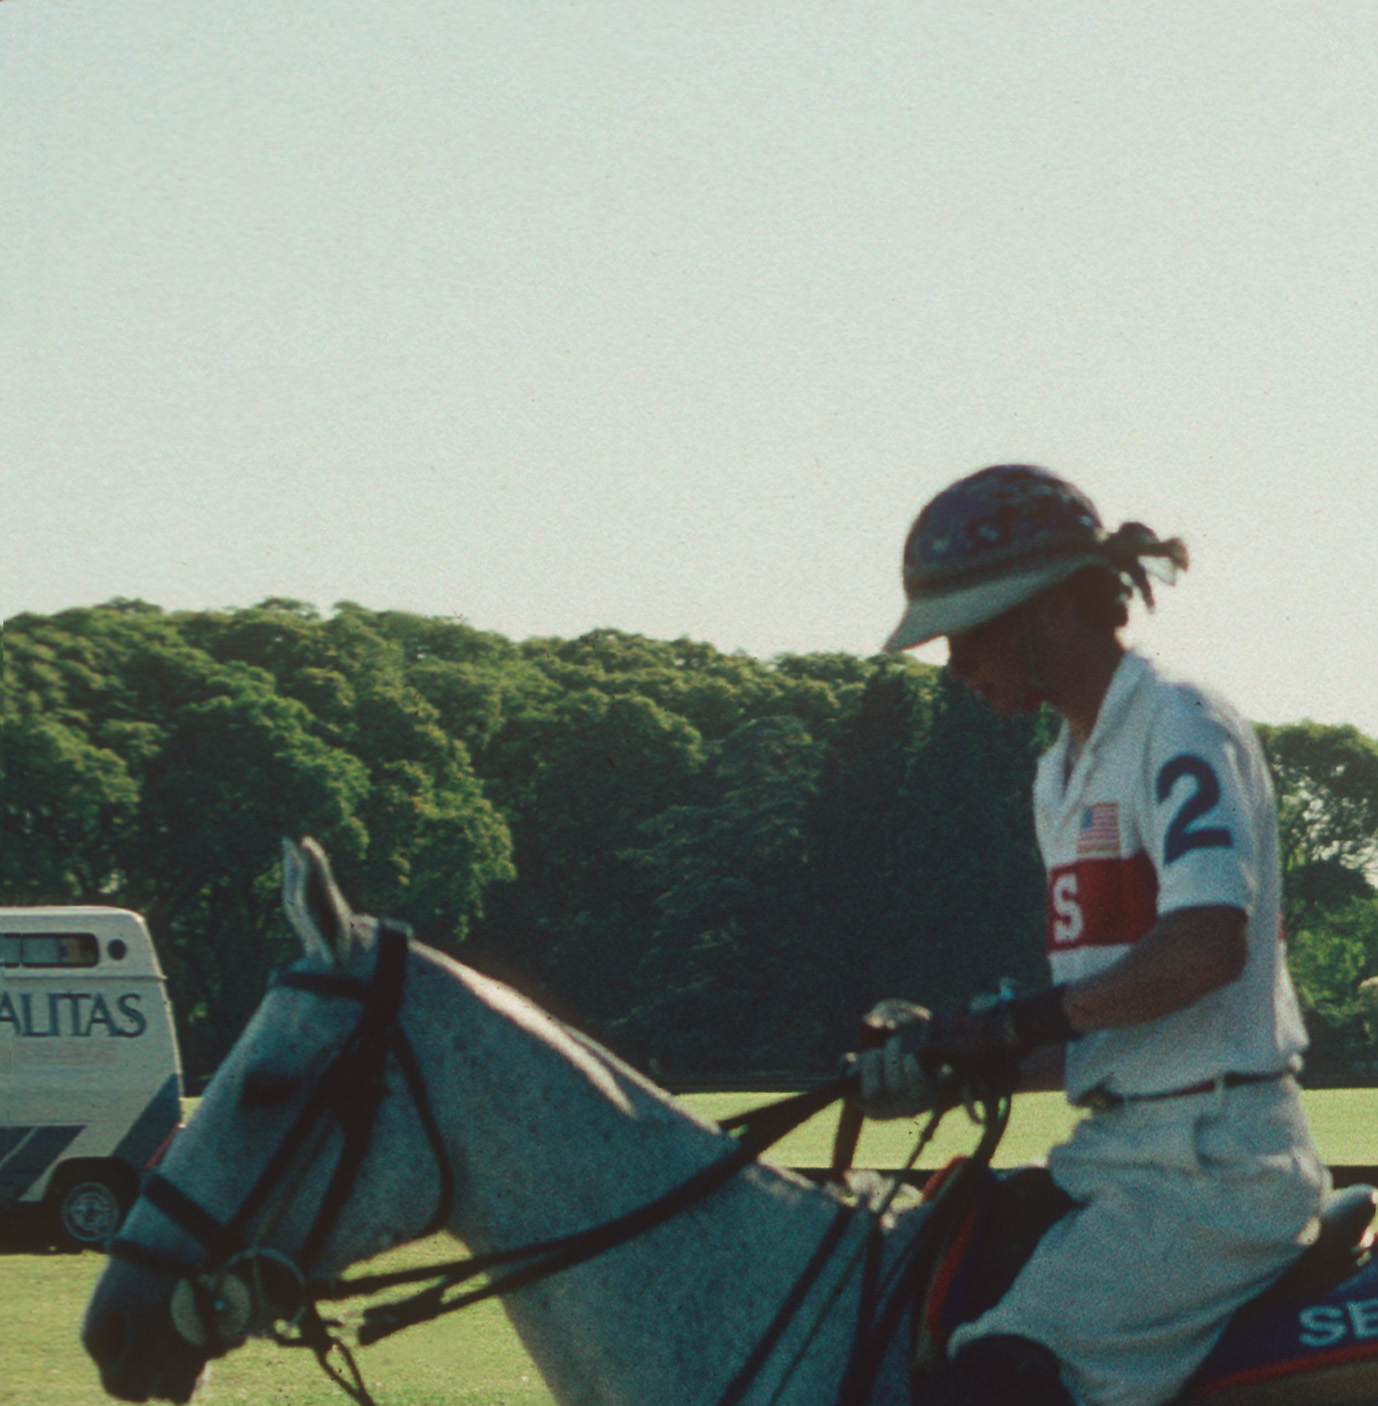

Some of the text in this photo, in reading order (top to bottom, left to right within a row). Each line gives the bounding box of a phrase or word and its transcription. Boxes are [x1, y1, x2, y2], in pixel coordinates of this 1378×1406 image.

[1156, 754, 1232, 866] 2
[1052, 872, 1084, 944] S
[0, 991, 147, 1038] ALITAS
